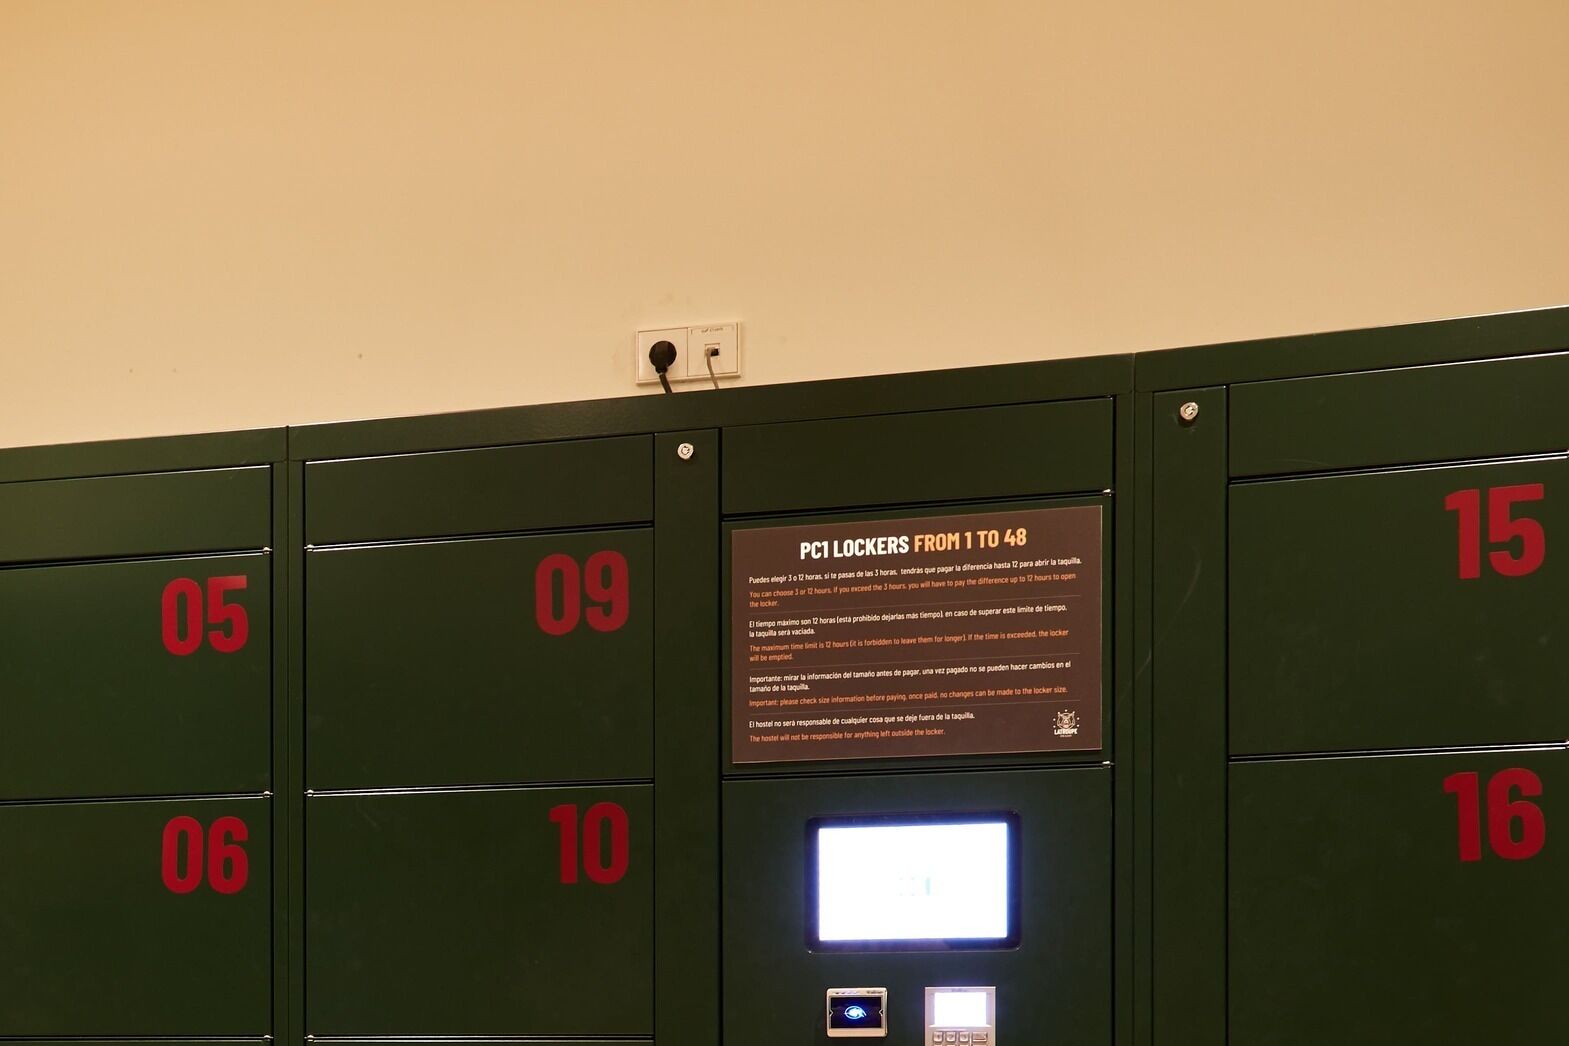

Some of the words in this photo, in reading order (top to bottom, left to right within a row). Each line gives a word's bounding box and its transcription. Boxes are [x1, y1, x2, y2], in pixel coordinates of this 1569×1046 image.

[748, 575, 770, 584] Puedes
[770, 574, 788, 584] elegir
[787, 573, 793, 582] 3
[797, 573, 805, 582] 12
[823, 571, 830, 580] si
[830, 572, 837, 580] te
[837, 571, 856, 580] pasas
[855, 570, 865, 578] de
[864, 569, 874, 578] las
[874, 568, 879, 577] 3
[923, 566, 936, 575] que
[936, 565, 955, 574] pagar
[954, 564, 962, 572] la
[961, 562, 993, 572] diferencia
[993, 561, 1011, 570] hasta
[1011, 559, 1019, 569] 12
[1018, 560, 1034, 569] para
[1033, 558, 1050, 567] abrir
[1050, 558, 1057, 566] la
[799, 540, 829, 560] PC1
[832, 535, 910, 558] LOCKERS
[913, 531, 960, 553] FROM
[963, 530, 972, 550] 1
[976, 529, 1000, 549] TO
[1003, 527, 1027, 547] 48
[1445, 484, 1545, 580] 15
[162, 577, 249, 656] 05
[536, 551, 629, 636] 09
[748, 684, 772, 693] tamaño
[771, 684, 780, 692] de
[780, 683, 787, 692] la
[783, 673, 800, 682] mirar
[800, 673, 807, 681] la
[806, 671, 842, 681] información
[842, 671, 852, 679] del
[852, 670, 876, 679] tamaño
[875, 669, 893, 678] antes
[893, 668, 902, 677] de
[934, 667, 946, 675] vez
[945, 665, 969, 676] pagado
[978, 665, 986, 673] se
[986, 663, 1010, 673] pueden
[1009, 663, 1028, 671] hacer
[1028, 661, 1056, 670] cambios
[1055, 661, 1065, 669] en
[1064, 660, 1072, 668] el
[748, 720, 755, 729] El
[755, 720, 774, 728] hostel
[773, 720, 782, 728] no
[796, 717, 832, 728] responsable
[831, 717, 840, 725] de
[840, 716, 869, 726] cualquier
[868, 716, 884, 724] cosa
[883, 715, 896, 724] que
[904, 713, 918, 723] deje
[918, 713, 935, 721] fuera
[935, 712, 944, 721] de
[944, 712, 951, 721] la
[549, 803, 629, 884] 10
[1444, 768, 1545, 862] 16
[162, 817, 249, 895] 06
